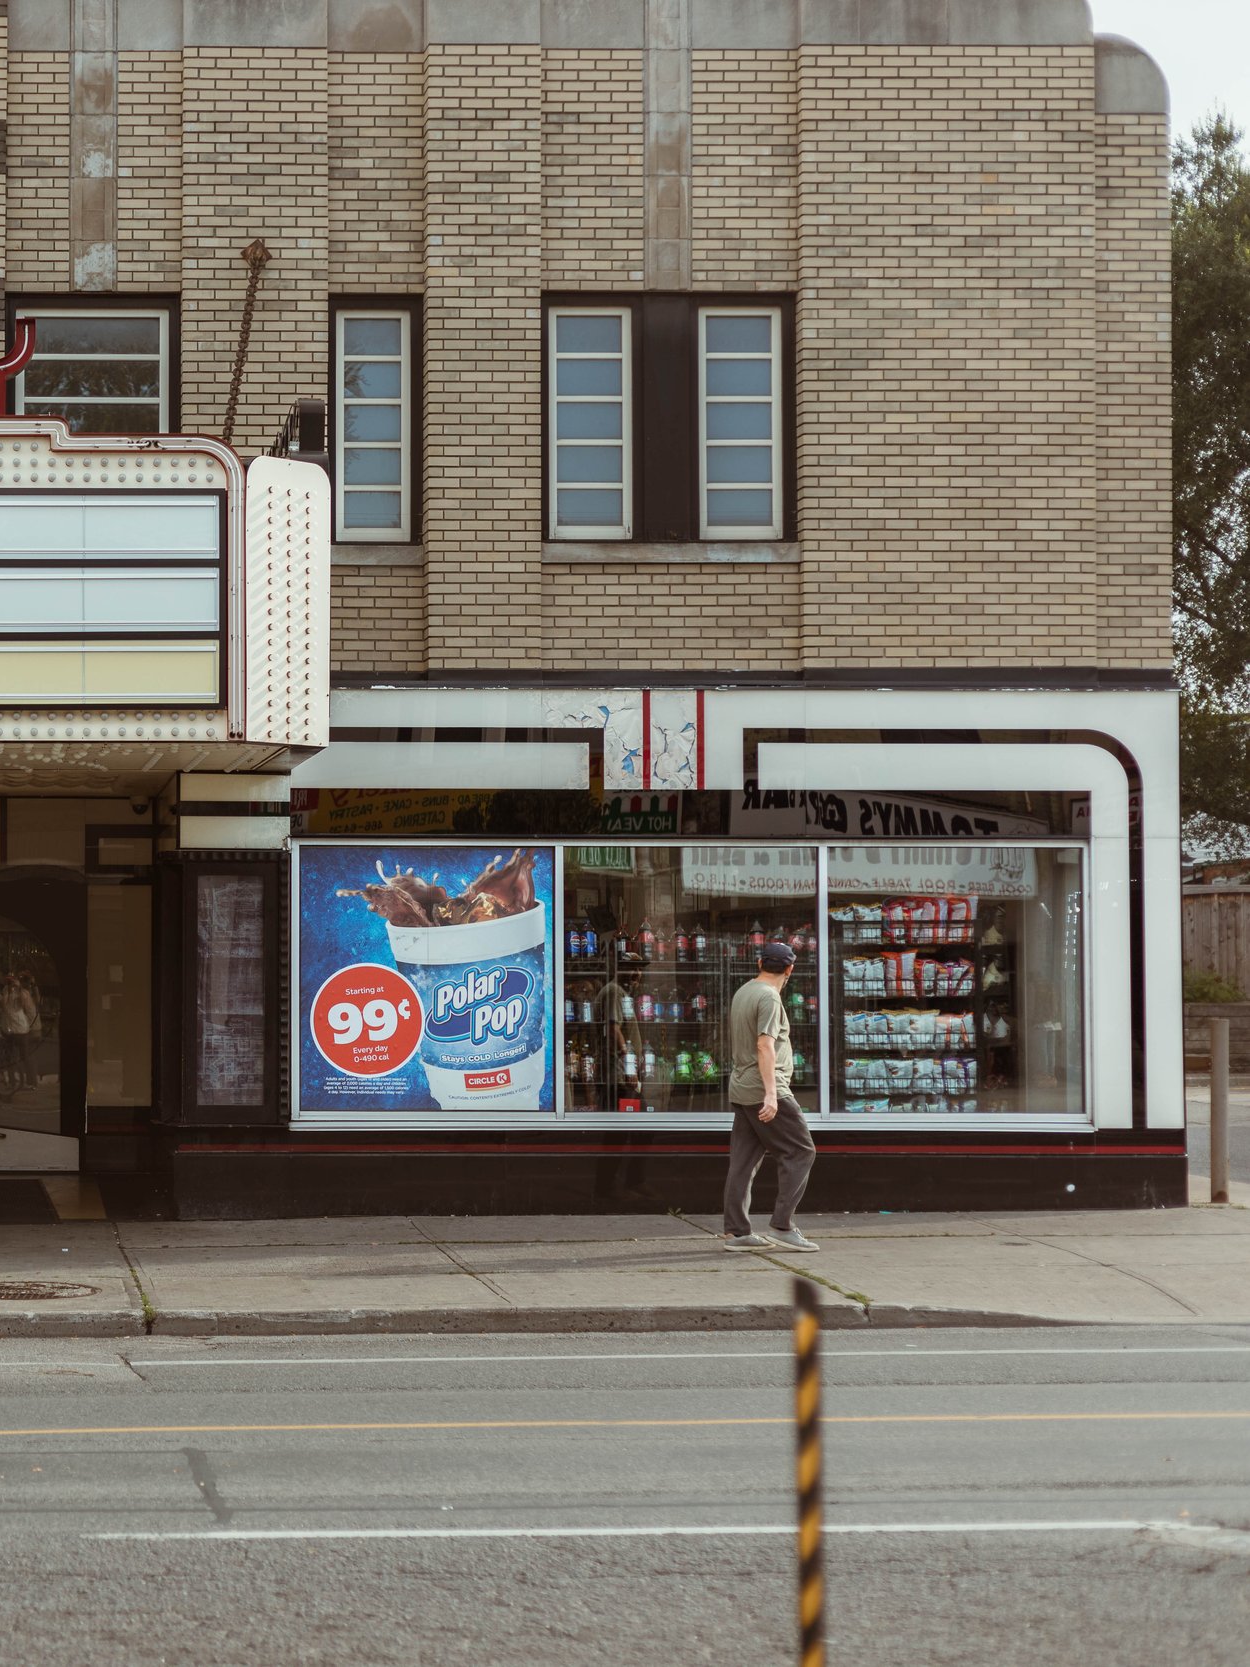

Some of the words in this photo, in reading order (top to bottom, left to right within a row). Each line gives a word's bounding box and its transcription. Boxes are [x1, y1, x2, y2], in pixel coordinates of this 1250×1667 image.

[345, 986, 375, 996] Starting
[435, 967, 503, 1019] Polar
[327, 998, 411, 1045] 99¢
[473, 998, 523, 1041] Pop
[352, 1045, 374, 1054] Every
[375, 1044, 388, 1053] day
[440, 1054, 465, 1064] Stays
[468, 1054, 491, 1062] COLD
[494, 1044, 526, 1060] Longer!
[353, 1054, 378, 1063] 0-490
[378, 1053, 389, 1061] cal
[468, 1076, 496, 1085] CIRCLE
[497, 1073, 507, 1082] K
